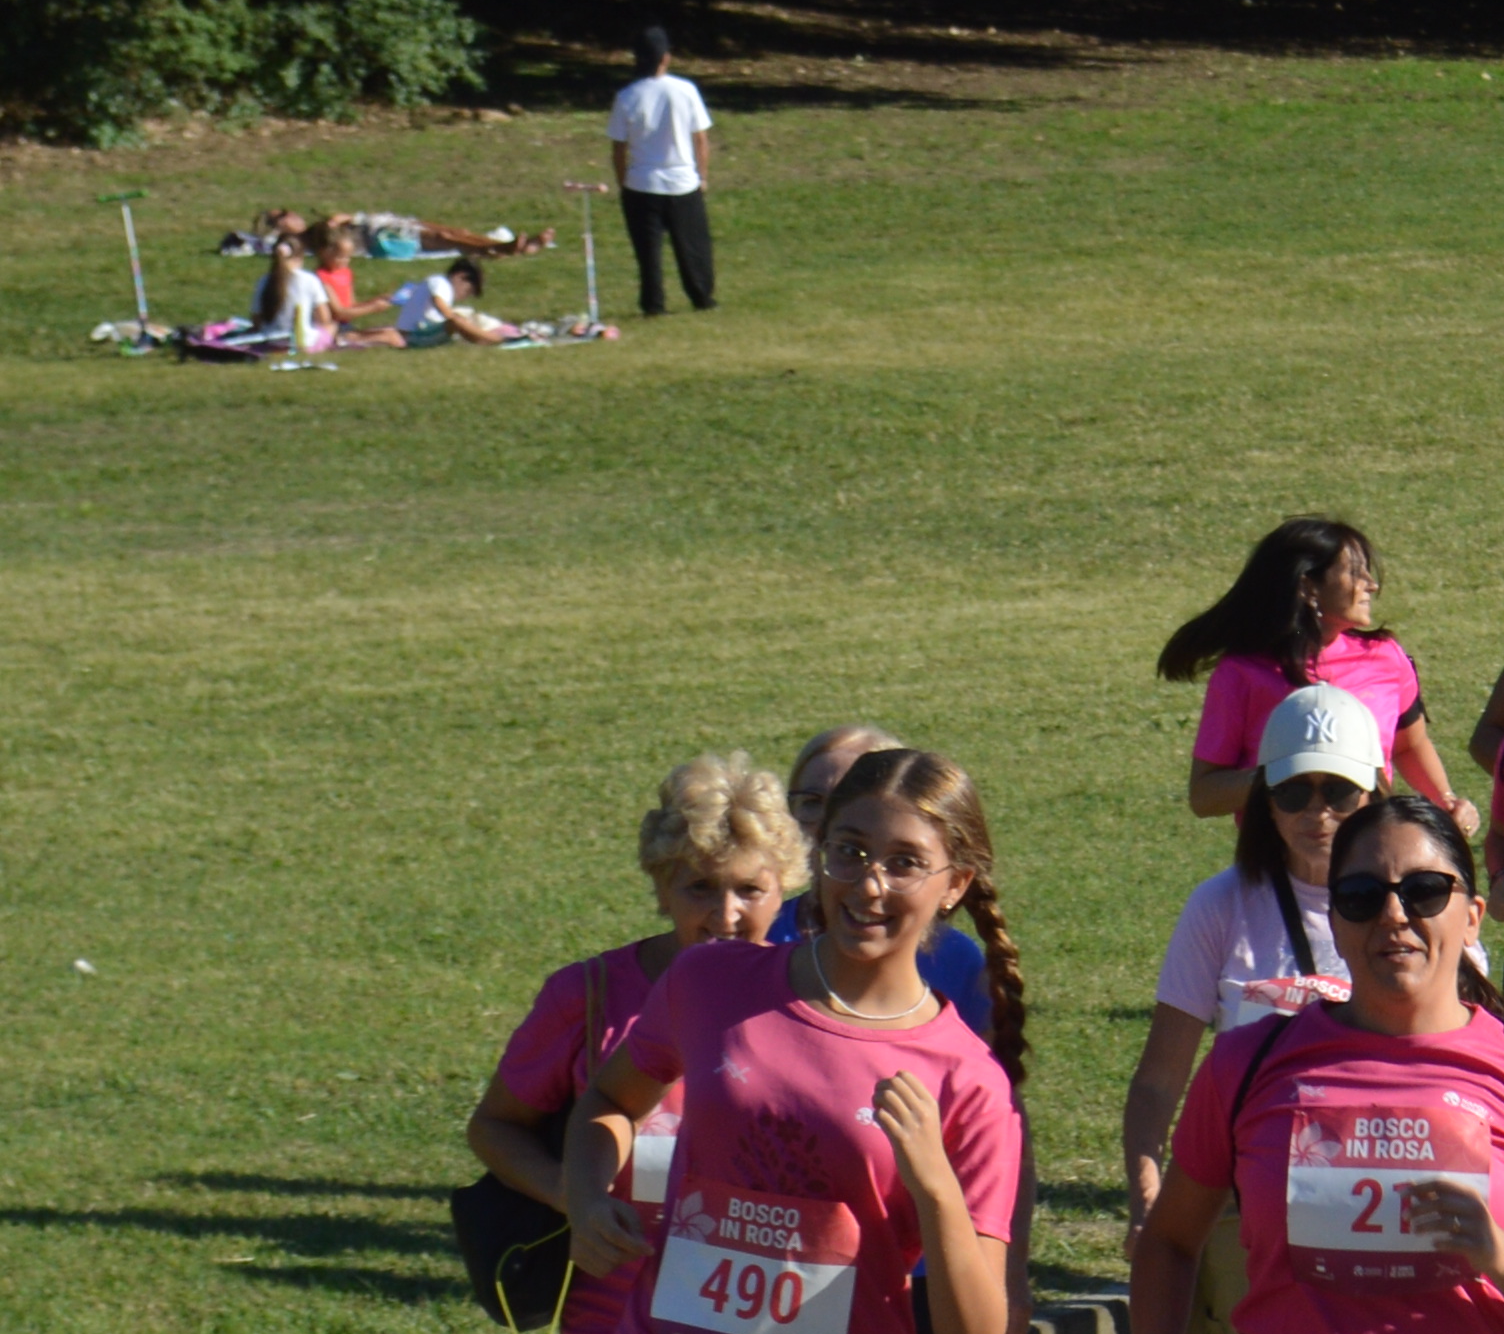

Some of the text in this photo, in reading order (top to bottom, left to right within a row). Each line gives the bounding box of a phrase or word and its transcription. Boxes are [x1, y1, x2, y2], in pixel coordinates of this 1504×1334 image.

[1293, 976, 1352, 1003] BOSCO
[1354, 1117, 1431, 1141] BOSCO
[1345, 1137, 1435, 1162] IN ROSA
[727, 1197, 799, 1229] BOSCO
[718, 1217, 803, 1253] IN ROSA
[697, 1257, 804, 1325] 490
